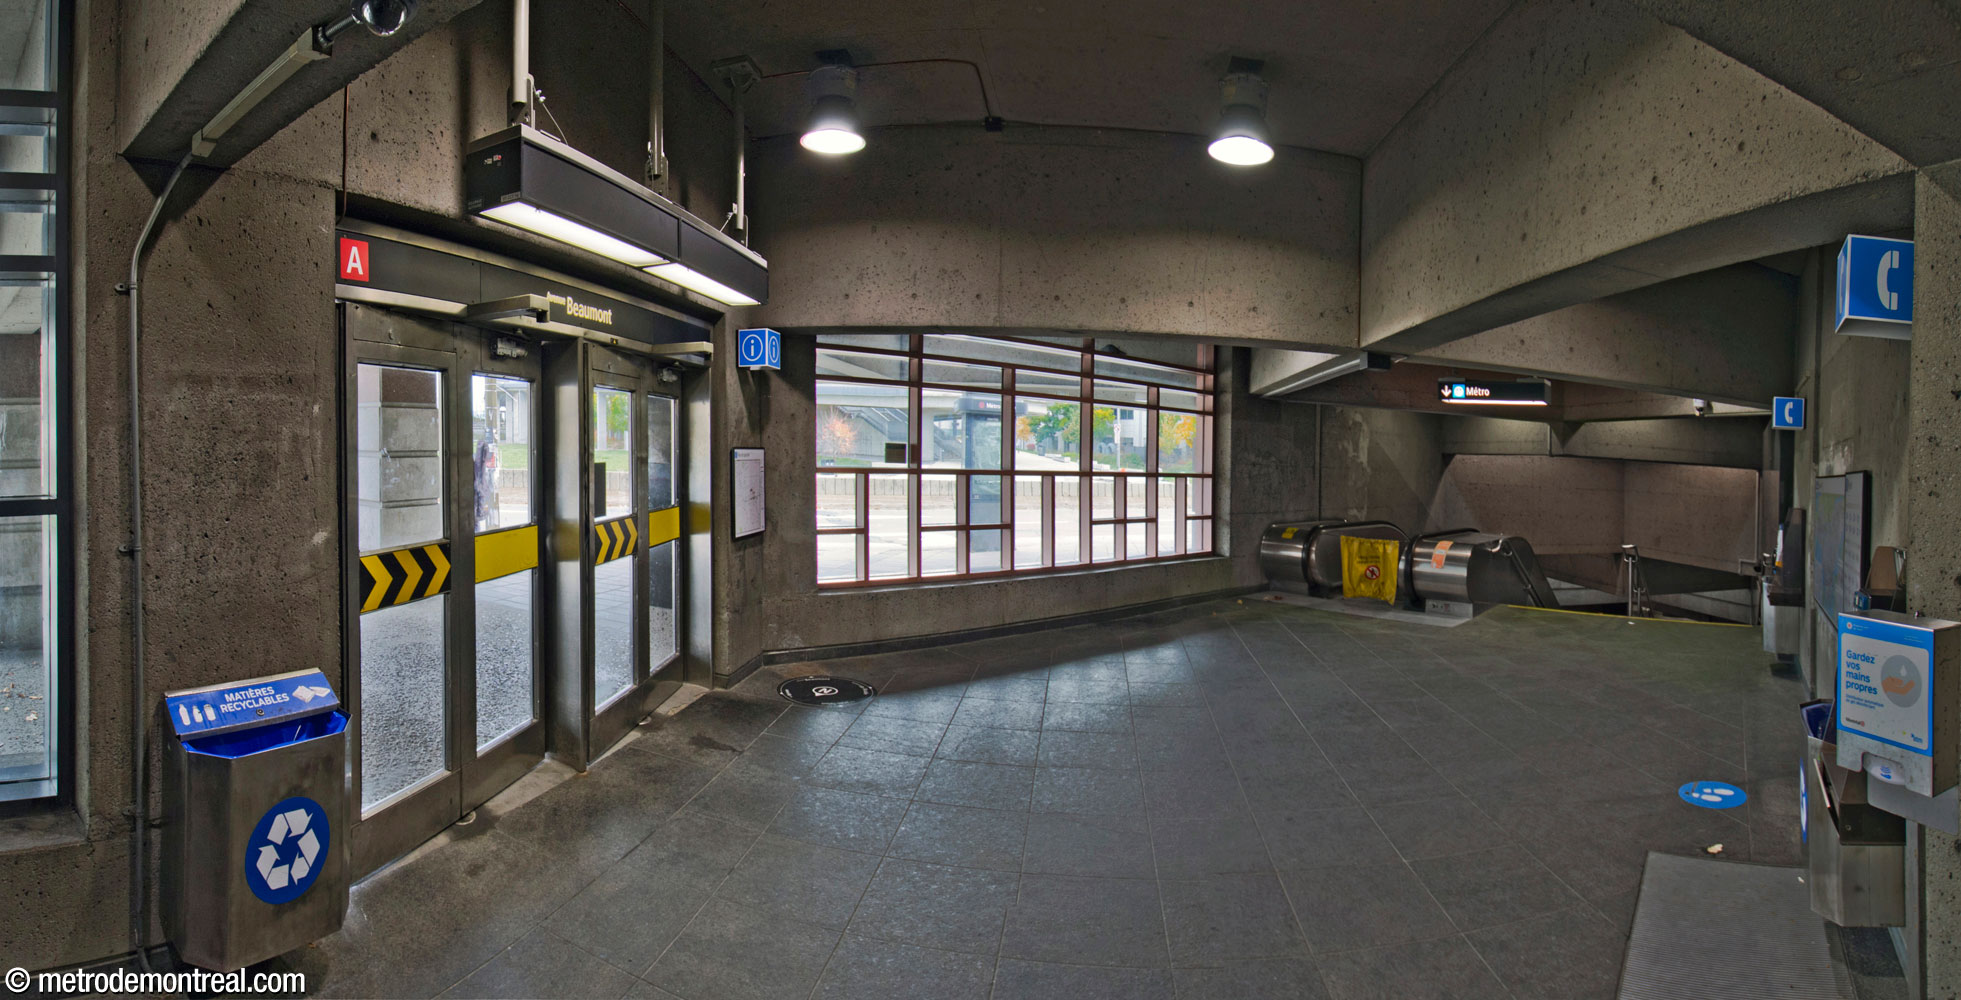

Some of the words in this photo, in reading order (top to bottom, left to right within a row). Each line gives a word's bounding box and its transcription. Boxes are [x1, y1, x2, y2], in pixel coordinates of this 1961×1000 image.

[346, 245, 364, 275] A
[566, 296, 613, 325] Beaumont
[1466, 386, 1490, 396] Métro
[1846, 649, 1876, 665] Gardez
[1846, 661, 1861, 671] vos
[1846, 670, 1871, 683] mains
[224, 686, 275, 703] MATIÈRES
[1846, 681, 1878, 695] propres
[220, 693, 290, 713] RECYCLABLES
